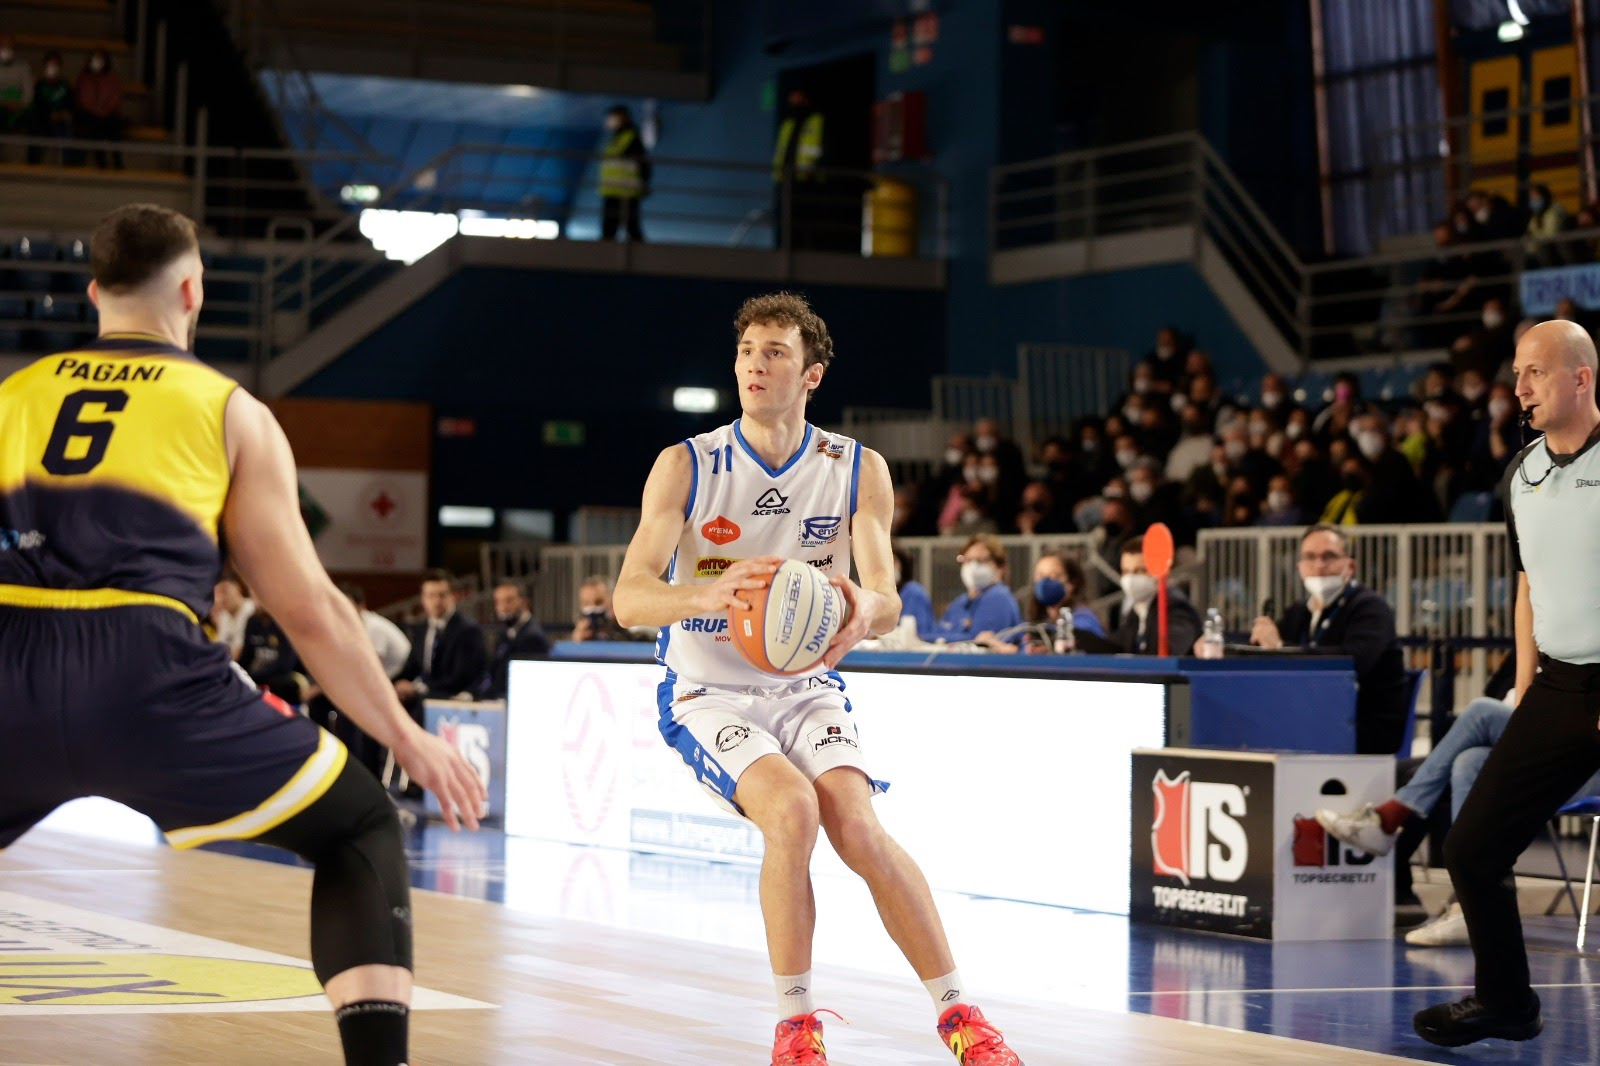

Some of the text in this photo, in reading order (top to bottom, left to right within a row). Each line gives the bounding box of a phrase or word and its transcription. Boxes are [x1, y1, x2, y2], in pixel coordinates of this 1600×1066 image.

[55, 358, 167, 382] PAGANI
[41, 388, 130, 476] 6
[709, 443, 733, 475] 11
[751, 507, 791, 516] ACERBIS
[780, 572, 803, 645] PRECISION
[805, 578, 834, 654] SPALDING
[1293, 872, 1376, 884] TOPSECRET.IT
[1153, 885, 1248, 917] TOPSECRET.IT
